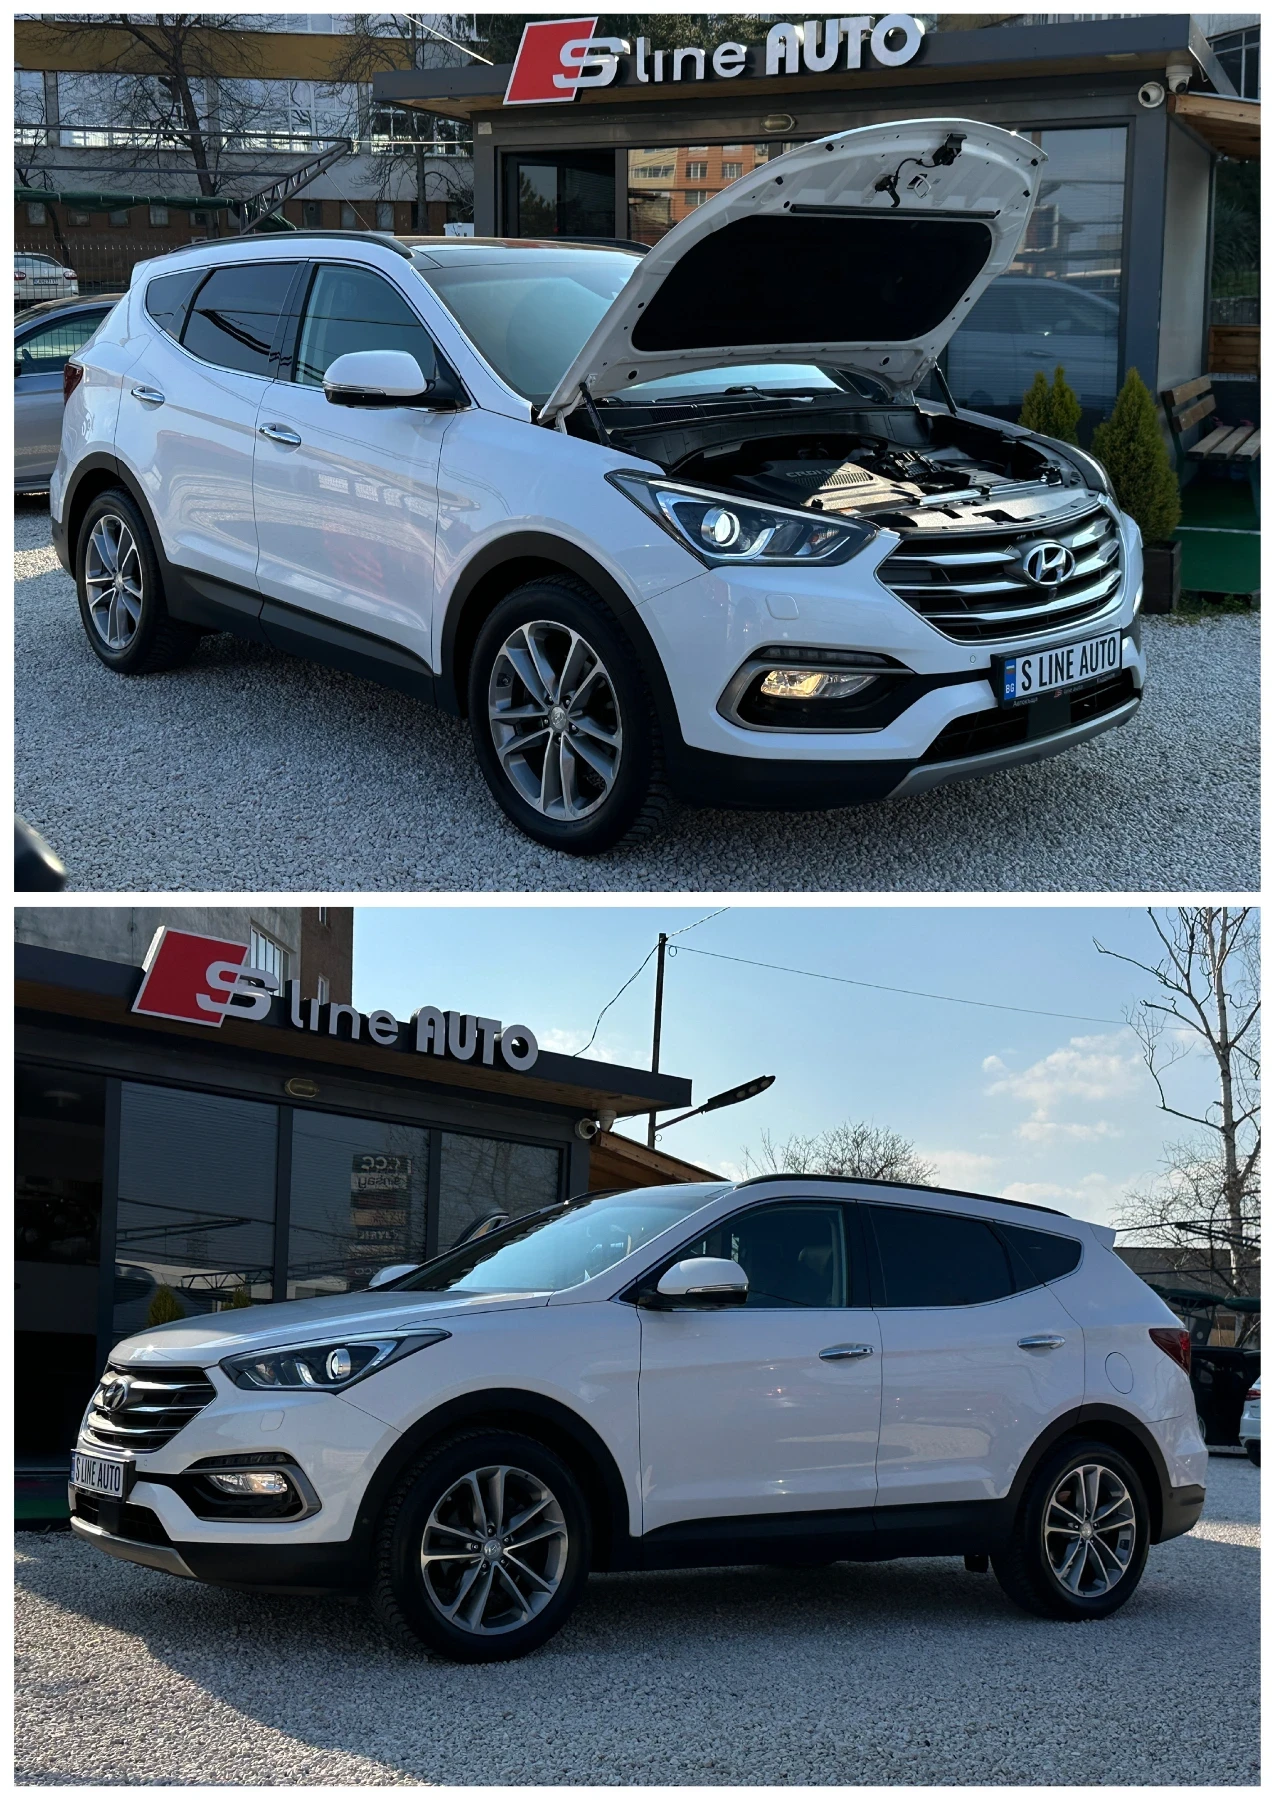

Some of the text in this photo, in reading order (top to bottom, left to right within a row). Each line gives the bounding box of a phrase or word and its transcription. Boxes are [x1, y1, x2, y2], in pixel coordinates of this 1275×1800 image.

[552, 14, 923, 89] S line AUTO
[1005, 683, 1015, 694] BG
[1021, 636, 1117, 692] S LINE AUTO
[195, 960, 540, 1072] S line AUTO
[76, 1456, 81, 1482] S
[81, 1458, 96, 1486] LINE
[97, 1462, 121, 1492] AUTO
